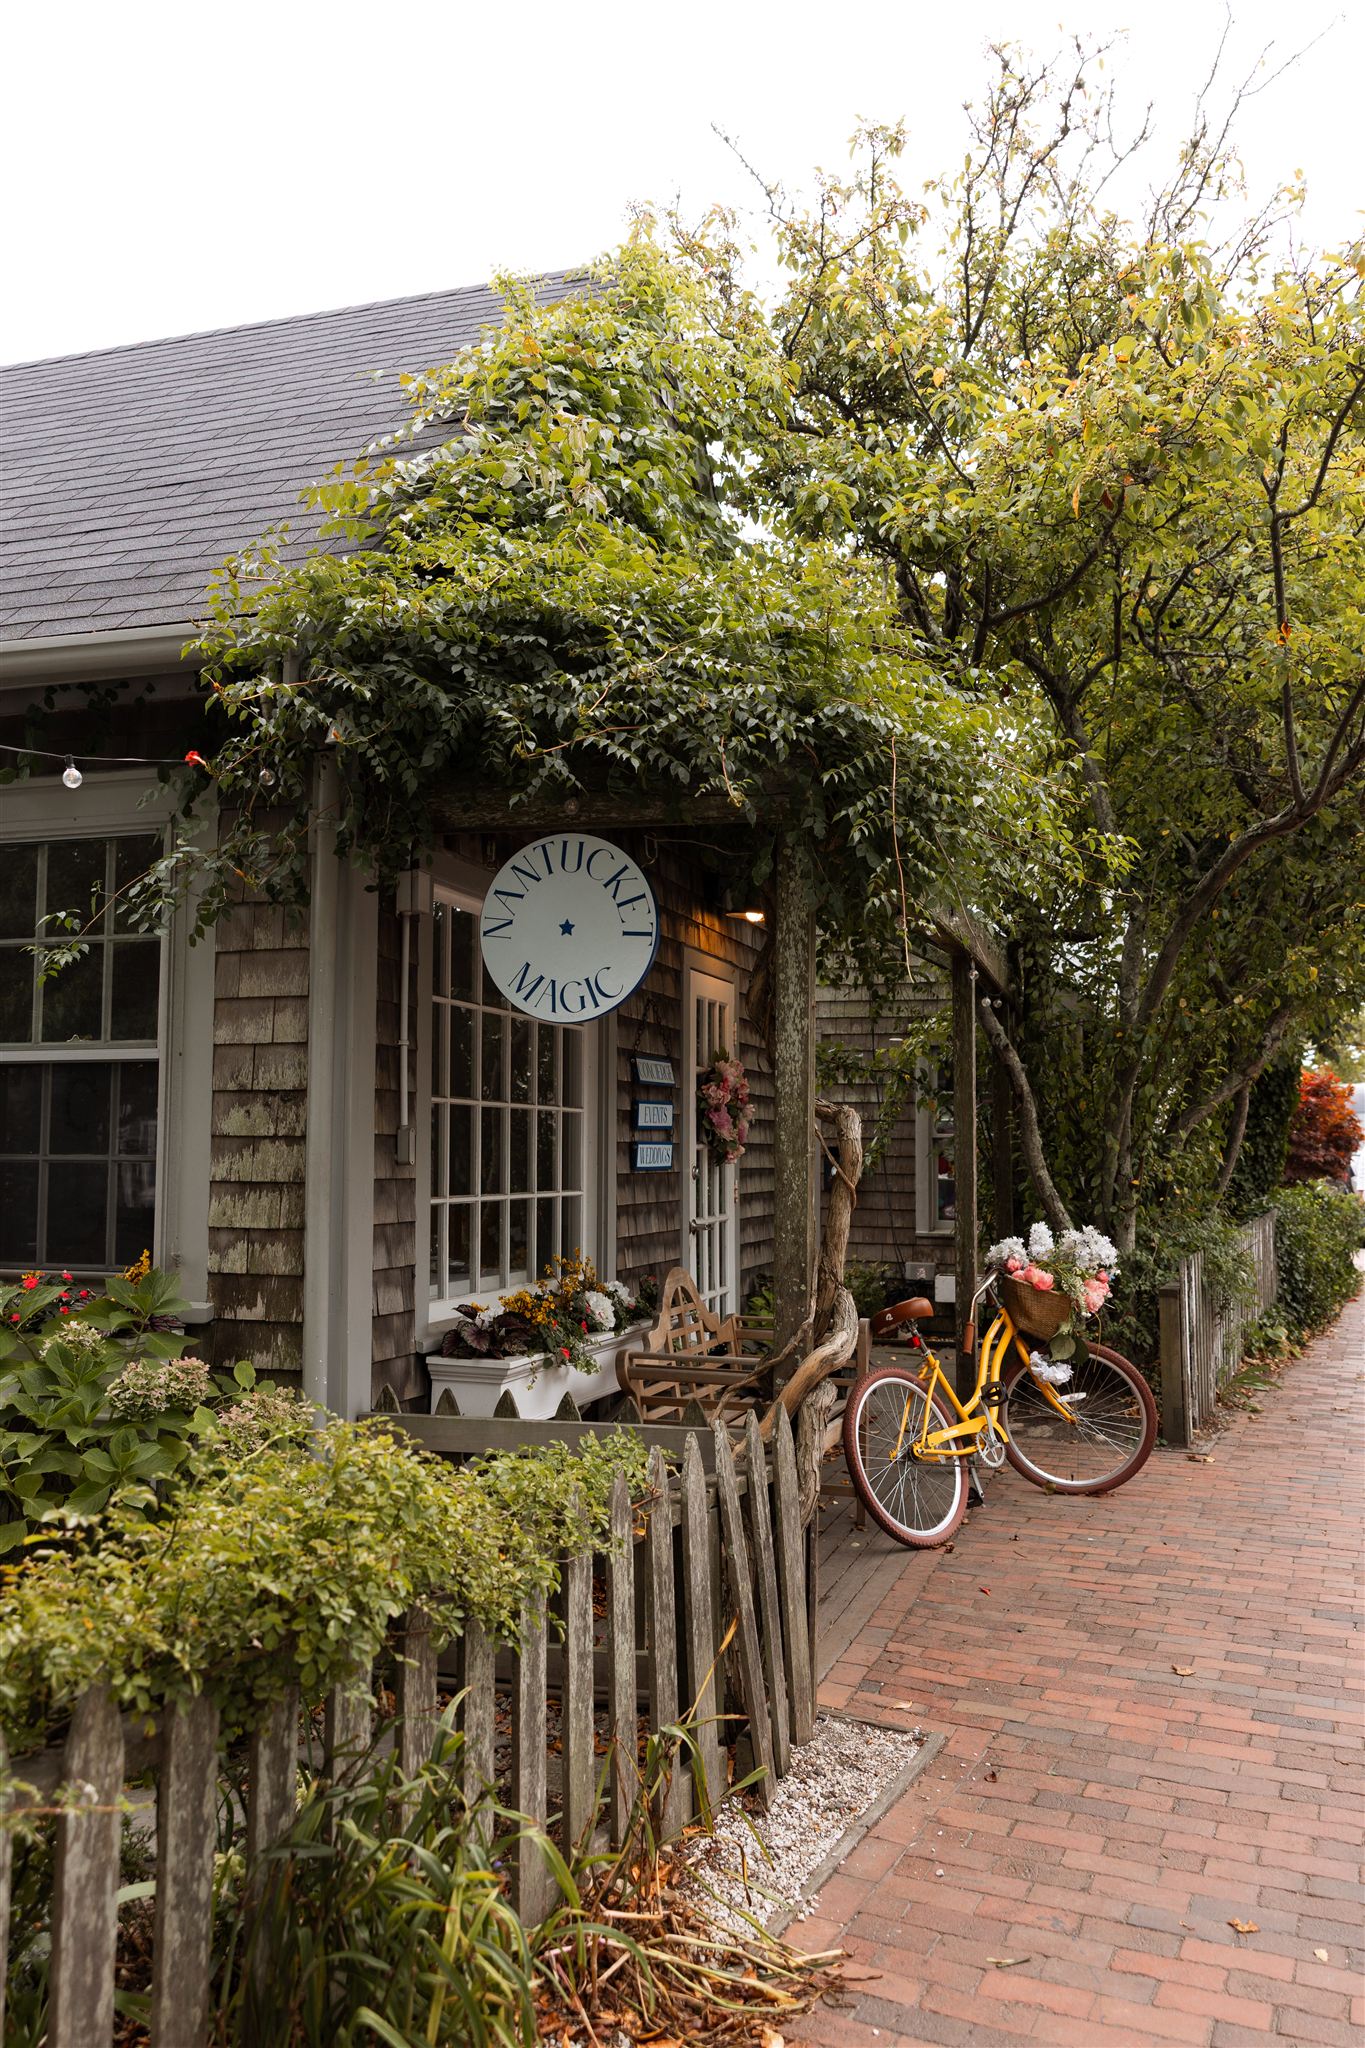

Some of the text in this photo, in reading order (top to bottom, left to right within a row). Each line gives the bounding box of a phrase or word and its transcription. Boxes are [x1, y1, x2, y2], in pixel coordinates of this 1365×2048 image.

[482, 840, 654, 947] NANTUCKET
[507, 961, 624, 1013] MAGIC
[643, 1105, 668, 1125] EVENTS
[639, 1146, 671, 1165] WEDDINGS
